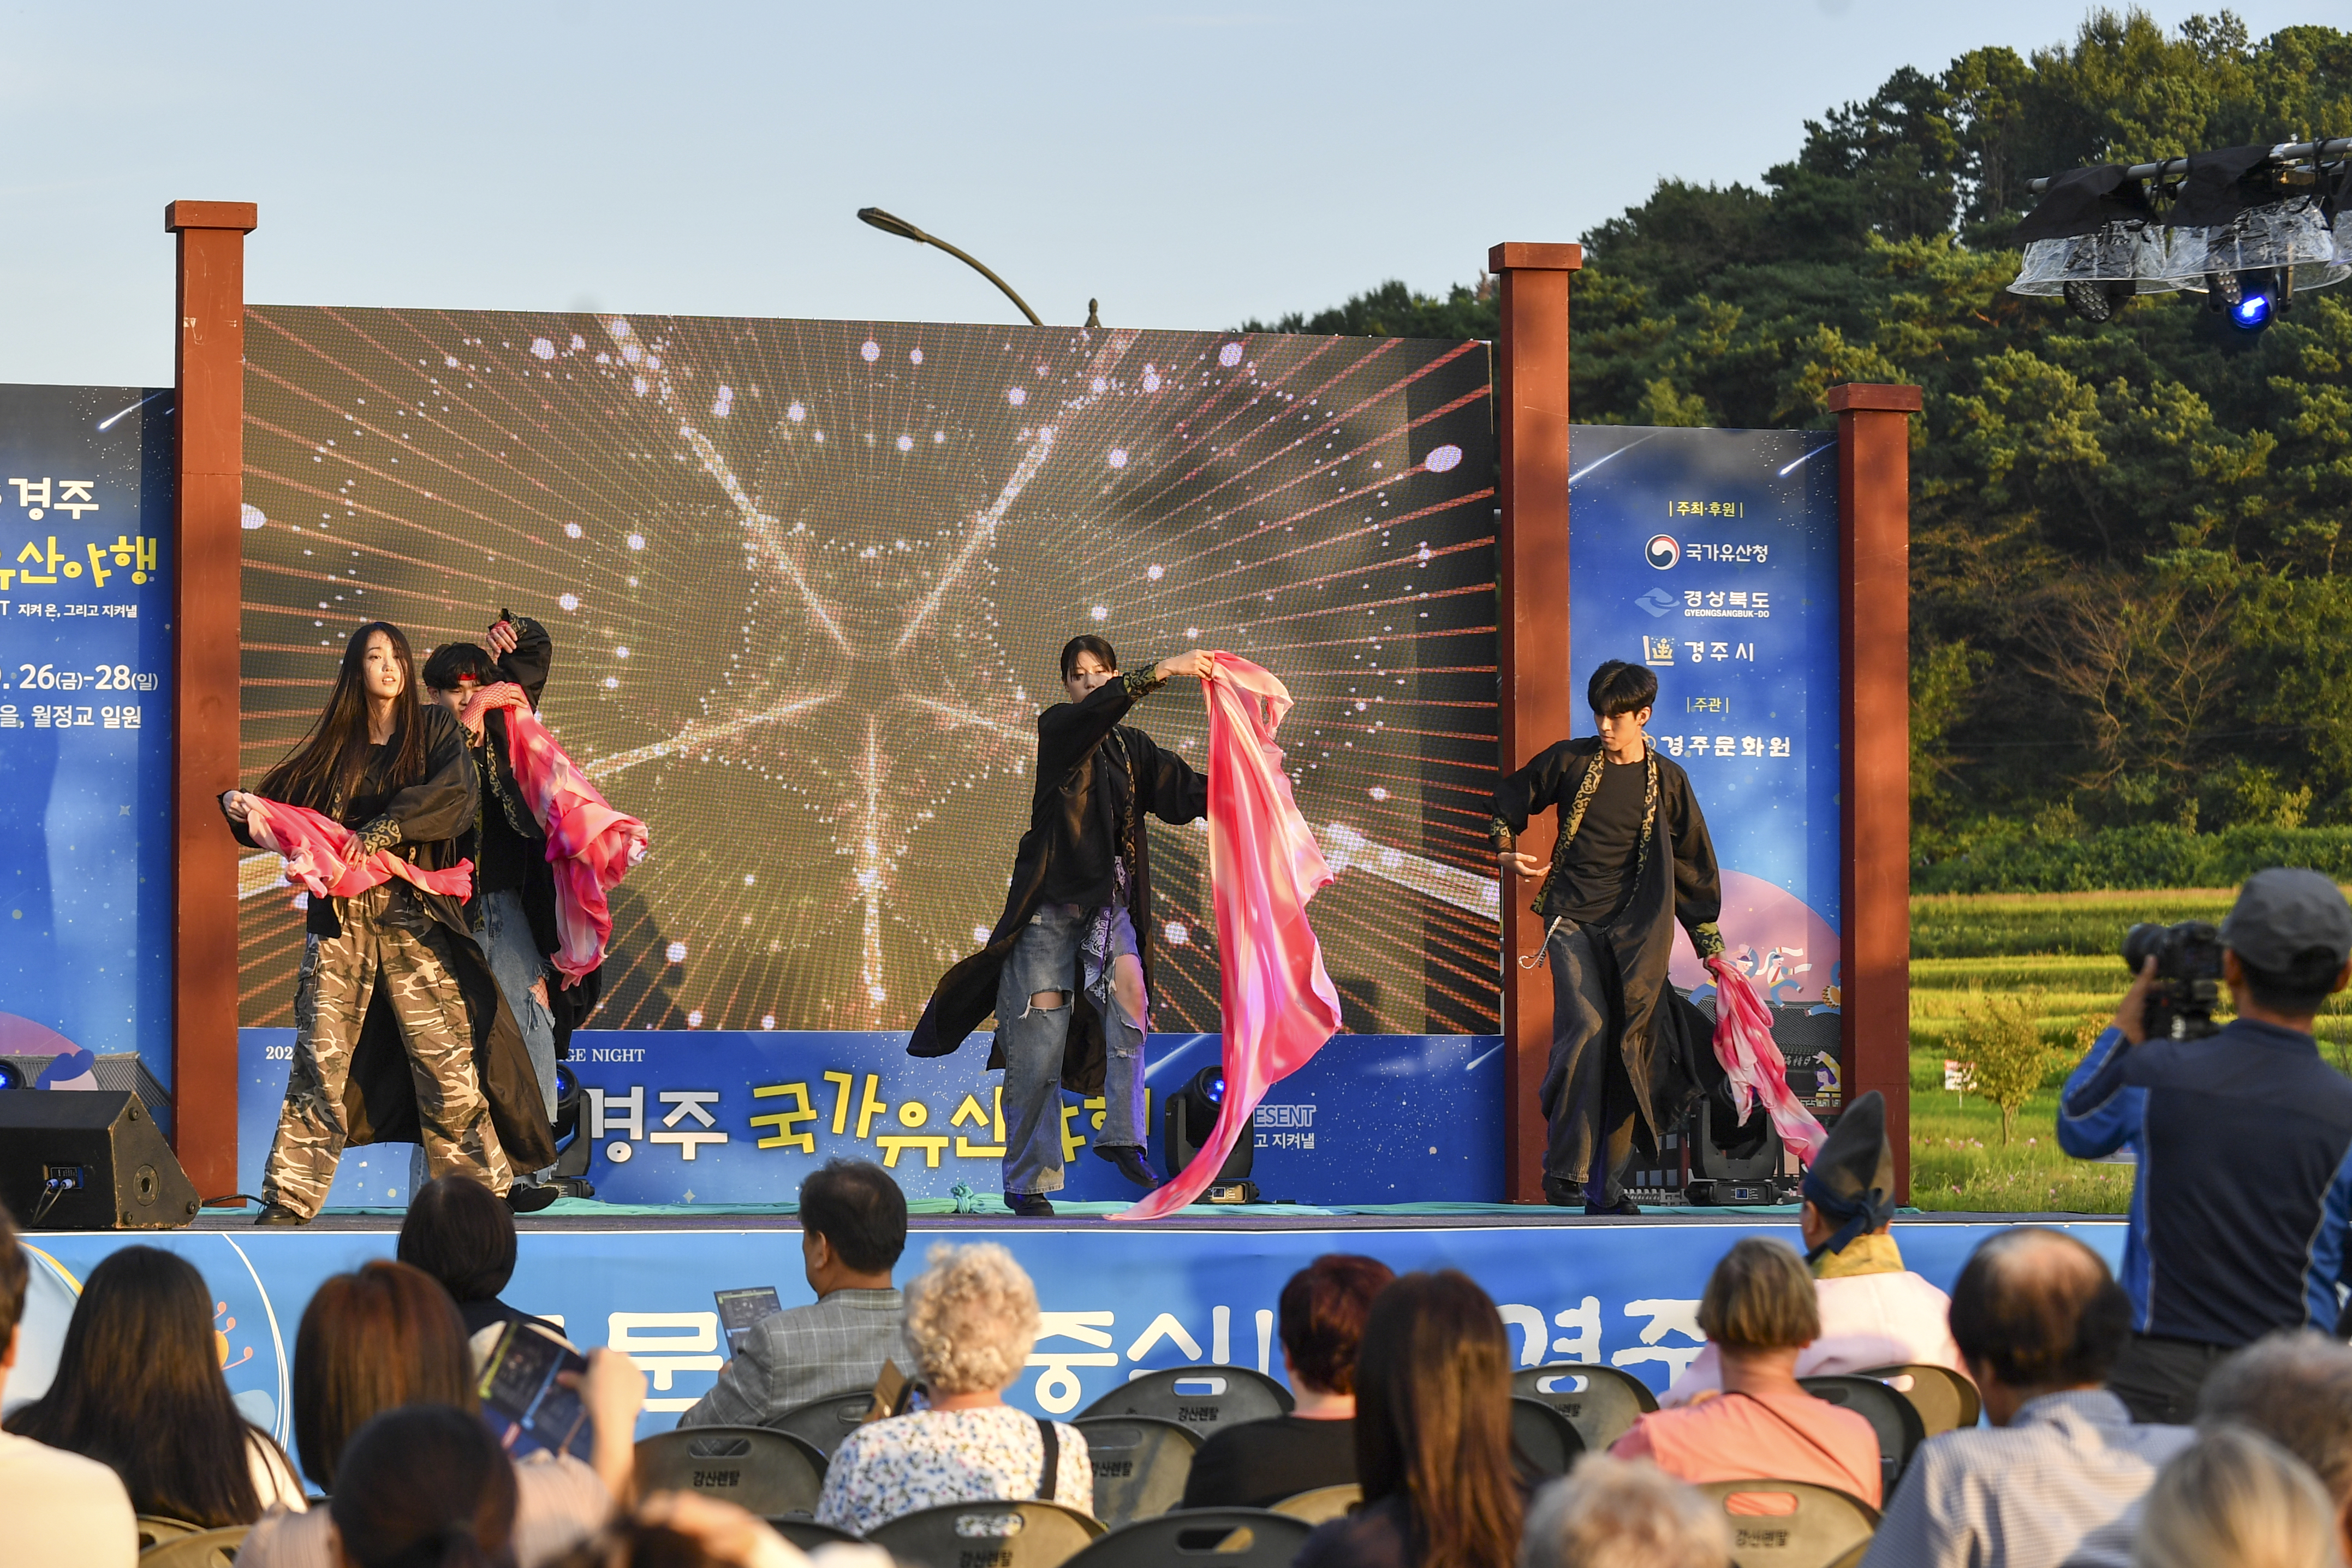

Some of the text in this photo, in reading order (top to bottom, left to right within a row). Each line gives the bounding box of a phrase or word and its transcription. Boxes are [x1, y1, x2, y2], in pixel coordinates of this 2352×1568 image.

[8, 477, 99, 520] 경주
[1686, 544, 1769, 563] 국가유산청
[1684, 591, 1770, 609] 경상북도
[18, 604, 41, 617] 지켜
[45, 604, 61, 618] 온,
[63, 604, 99, 617] 그리고
[102, 605, 138, 618] 지켜낼
[1684, 609, 1770, 619] GYEONGSANGBUK-DO
[1685, 642, 1754, 663] 경주시
[1694, 697, 1722, 713] 주관
[31, 705, 94, 728] 월정교
[101, 705, 141, 729] 일원
[1660, 736, 1791, 758] 경주문화원
[266, 1046, 294, 1060] 202
[558, 1048, 645, 1062] GE NIGHT
[583, 1086, 728, 1163] 경주
[1272, 1132, 1315, 1149] 지켜낼
